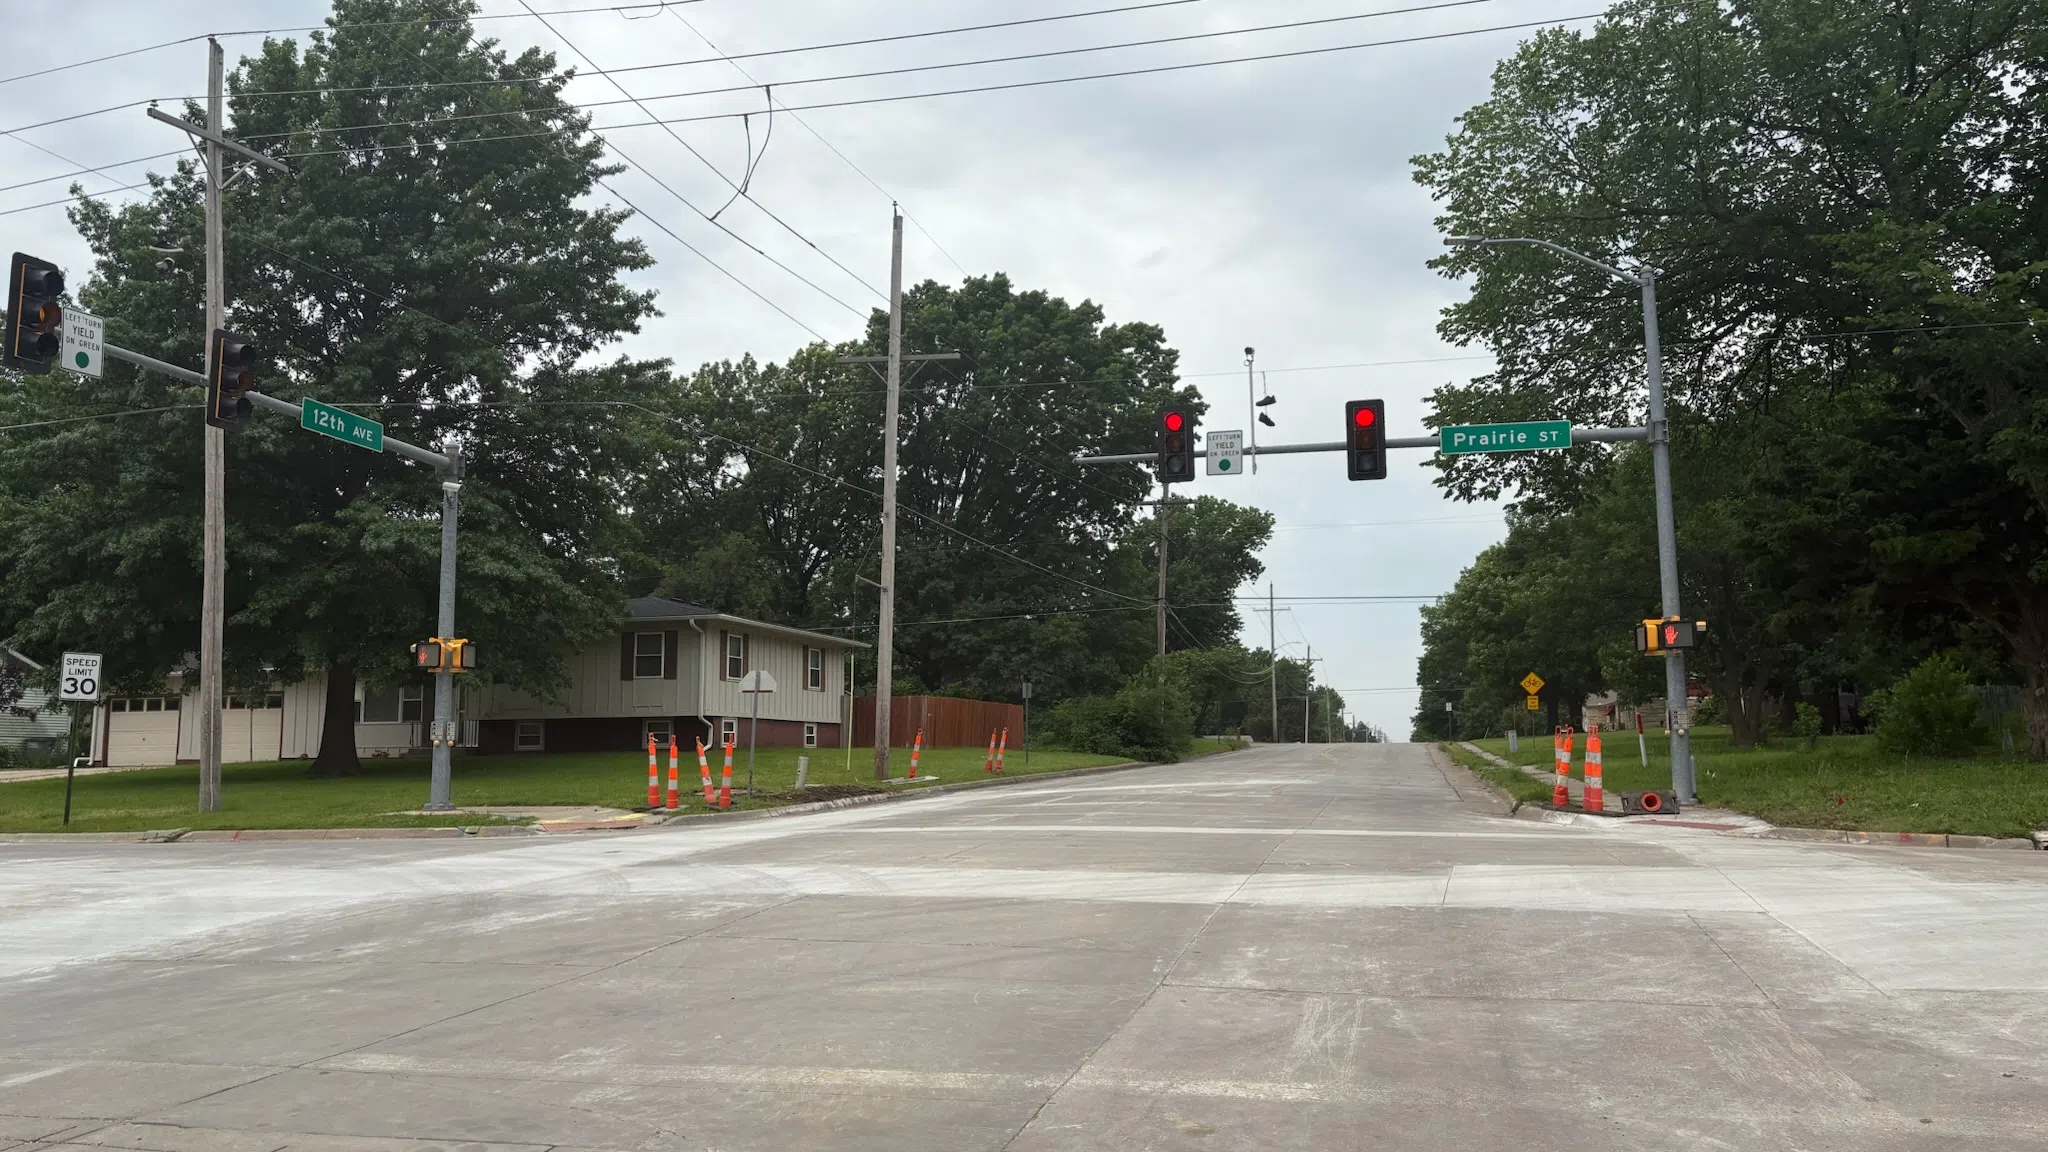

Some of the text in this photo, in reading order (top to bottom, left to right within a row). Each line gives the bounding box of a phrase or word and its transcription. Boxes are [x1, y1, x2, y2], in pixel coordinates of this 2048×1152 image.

[65, 312, 102, 329] LEFT TURN
[72, 325, 95, 340] YIELD
[65, 336, 100, 351] ON GREEN
[313, 408, 373, 442] 12th AVE
[1215, 441, 1235, 449] YIELD
[1453, 430, 1559, 447] Prairie ST
[66, 658, 98, 667] SPEED
[68, 668, 93, 676] LIMIT
[63, 677, 96, 695] 30
